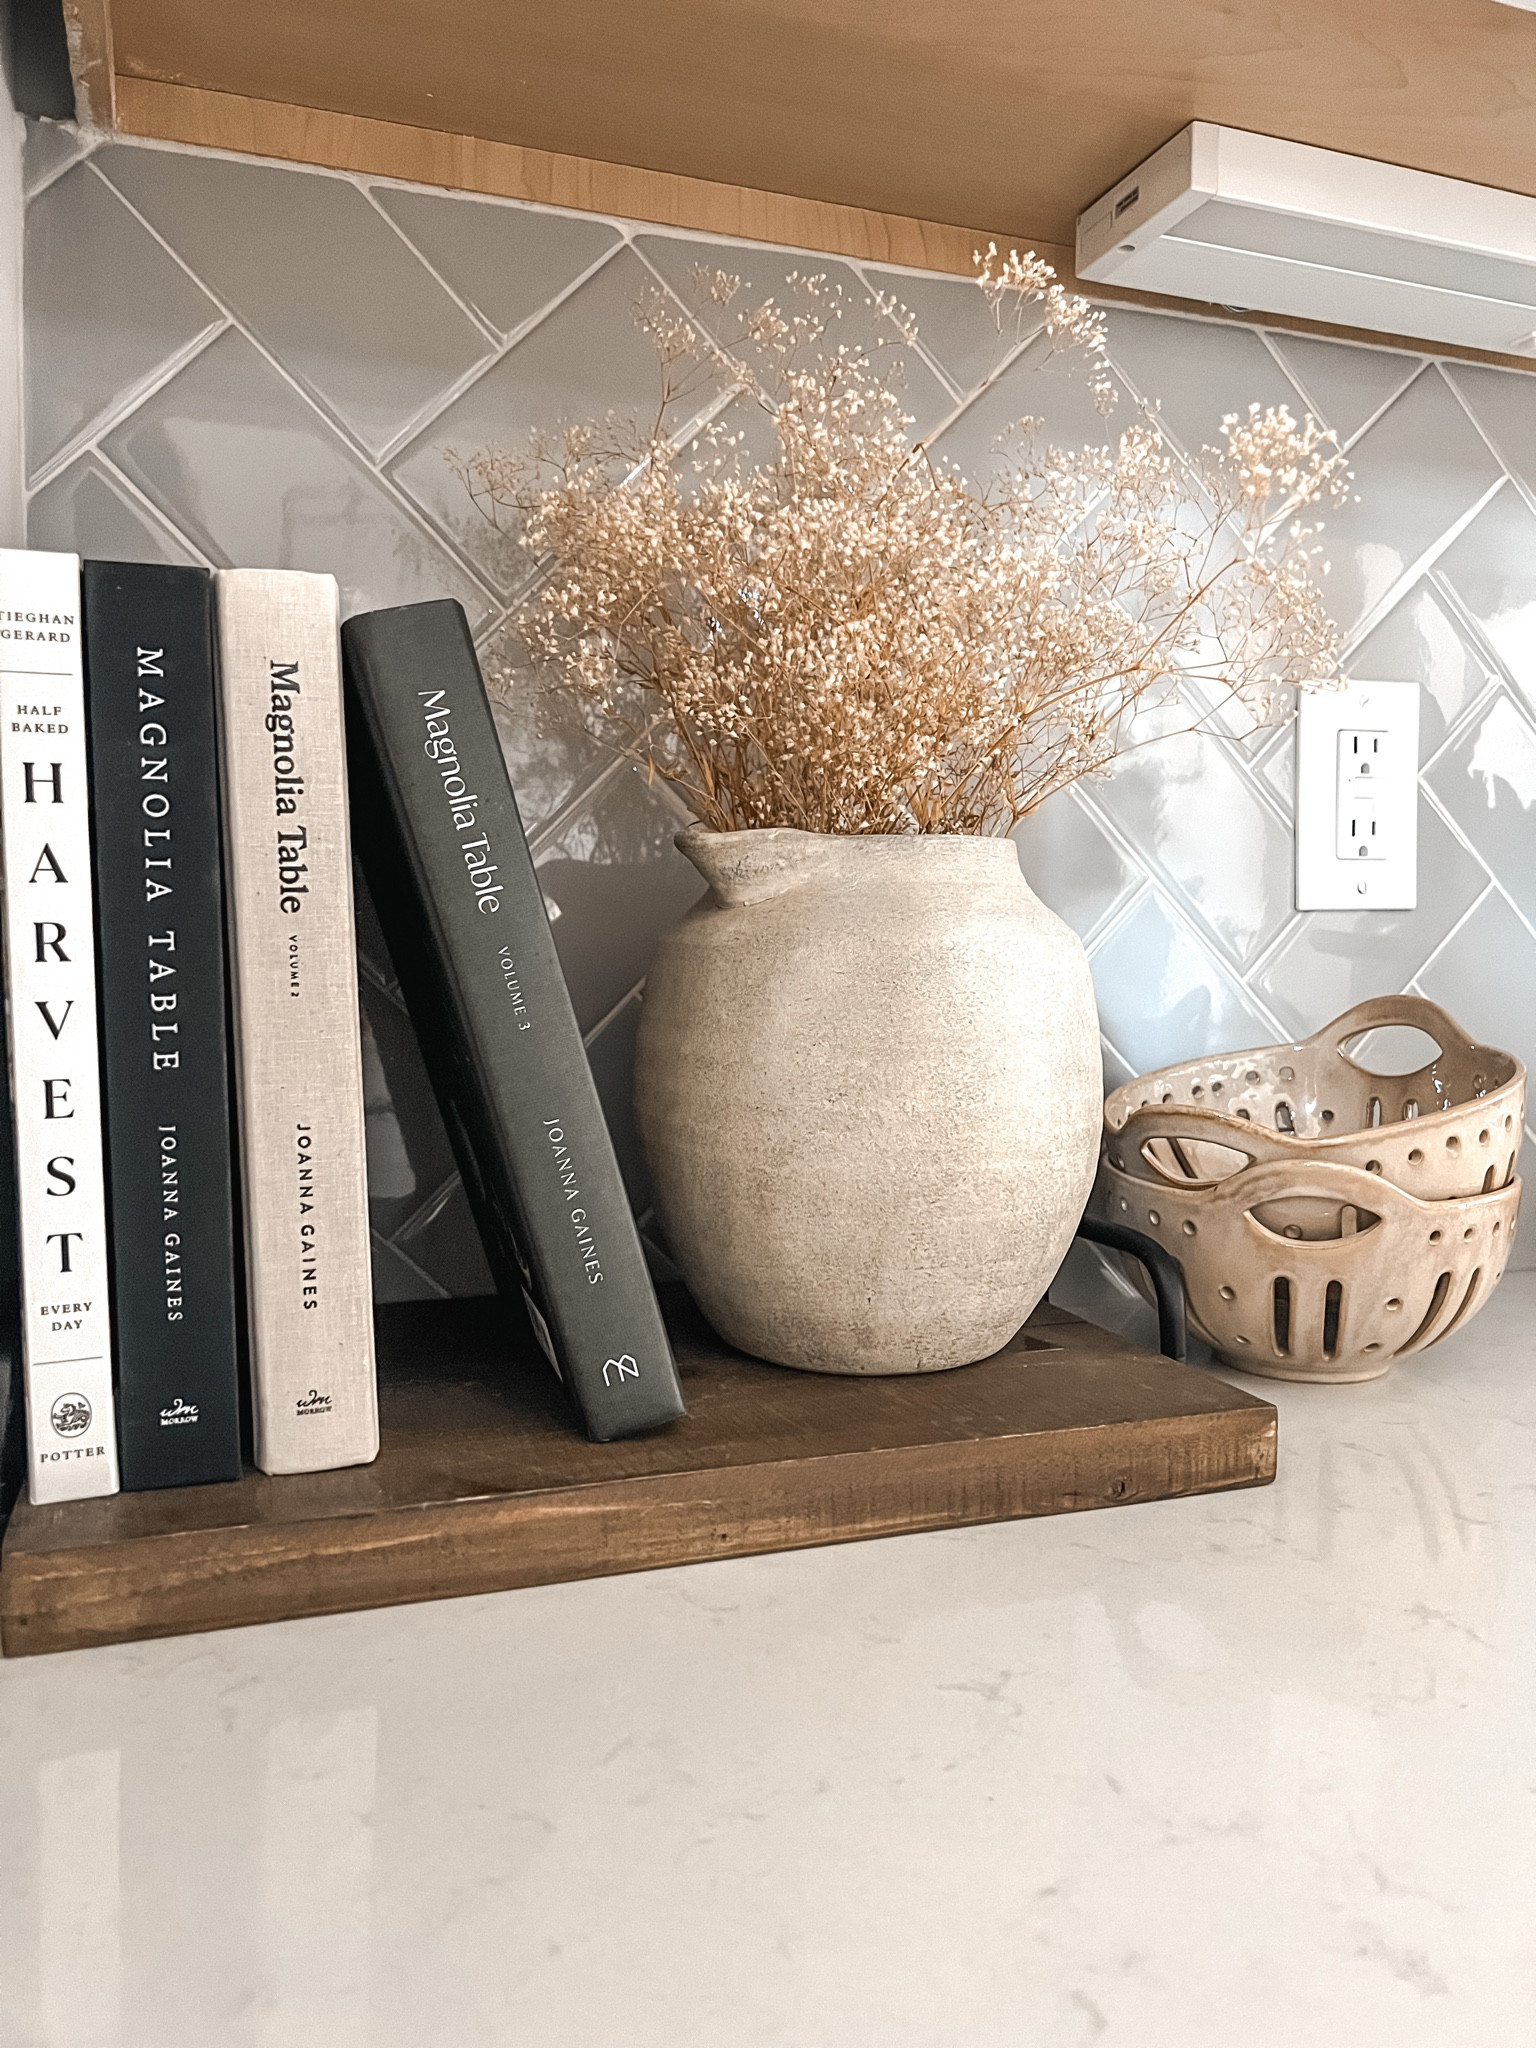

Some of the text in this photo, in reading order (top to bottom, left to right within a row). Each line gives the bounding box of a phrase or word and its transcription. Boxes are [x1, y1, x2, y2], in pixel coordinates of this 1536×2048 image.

[1, 629, 71, 643] GERARD
[11, 721, 69, 734] BAKED
[17, 704, 62, 716] HALF
[265, 660, 309, 914] Magnolia Table
[417, 689, 504, 914] Magnolia Table
[136, 645, 180, 1070] MAGNOLIA TABLE
[288, 934, 300, 987] VOLUME
[497, 946, 531, 1031] VOLUME 3
[22, 761, 83, 1273] HARVEST
[158, 1125, 183, 1321] JOANNA GAINES
[297, 1124, 318, 1310] JOANNA GAINES
[543, 1118, 604, 1285] JOANNA GAINES
[40, 1302, 92, 1316] EVERY
[51, 1319, 83, 1332] DAY
[160, 1415, 198, 1426] MORROW
[296, 1406, 332, 1416] MORROW
[40, 1446, 106, 1463] POTTER
